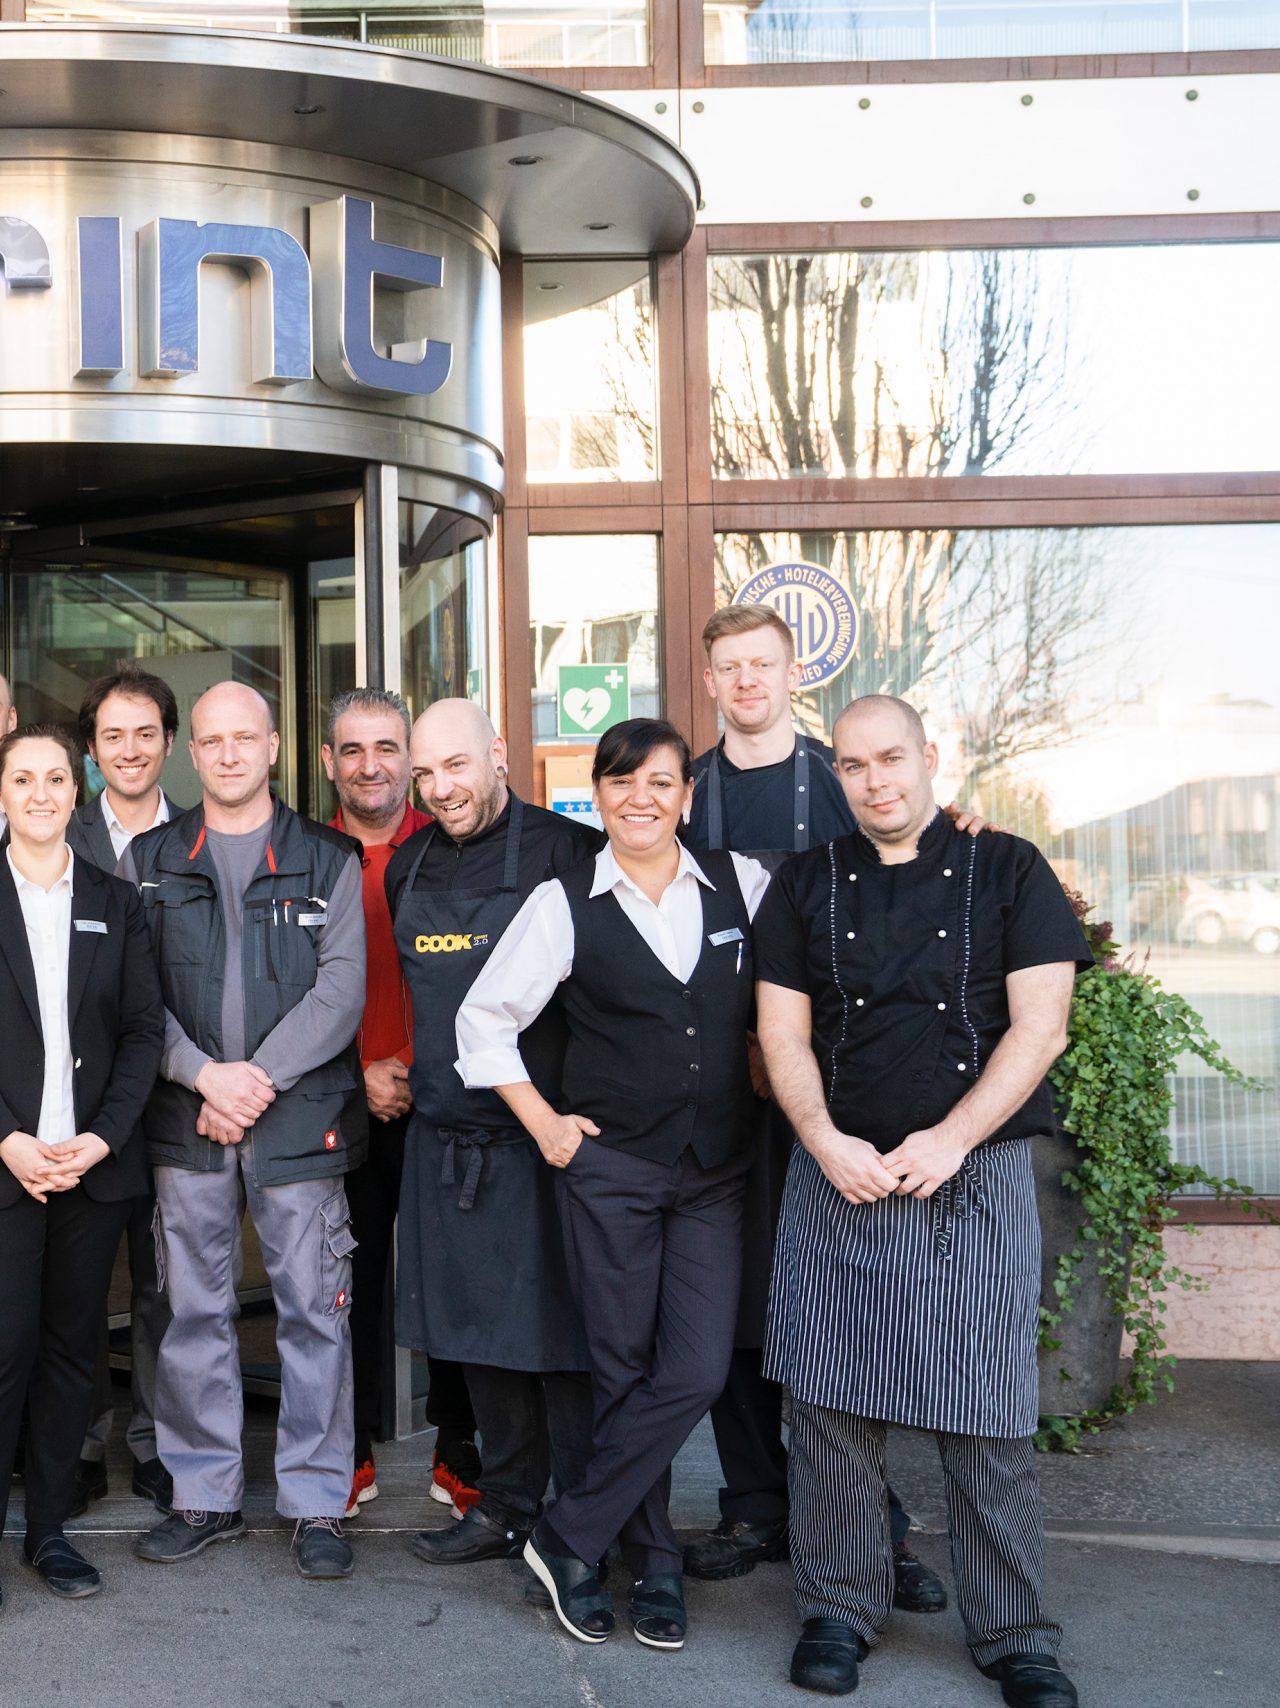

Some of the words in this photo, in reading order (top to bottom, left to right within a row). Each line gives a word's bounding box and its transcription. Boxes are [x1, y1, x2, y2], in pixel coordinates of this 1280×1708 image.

[784, 567, 852, 666] HOTELIERVEREINIGUNG
[800, 664, 823, 682] IED
[415, 934, 473, 953] COOK
[473, 938, 489, 946] 2.0
